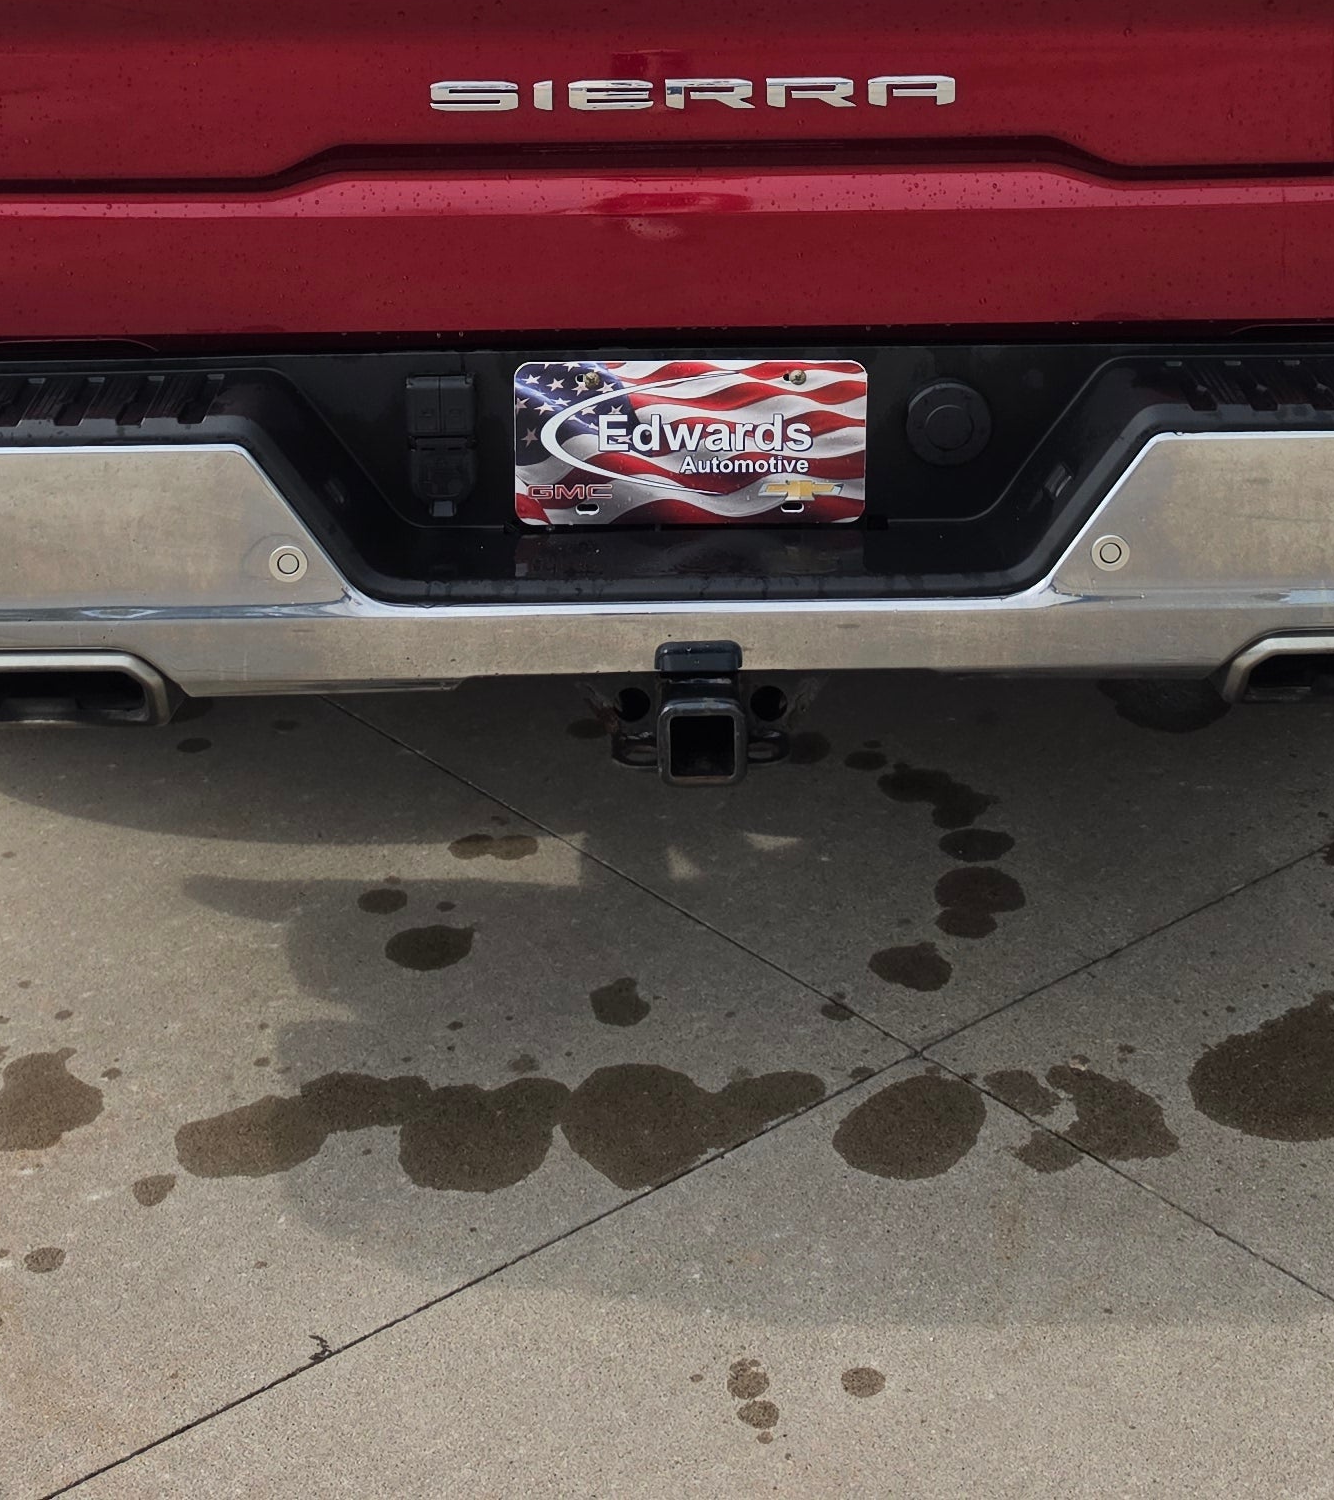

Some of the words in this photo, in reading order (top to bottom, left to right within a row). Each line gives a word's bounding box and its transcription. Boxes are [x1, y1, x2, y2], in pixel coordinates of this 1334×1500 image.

[429, 74, 956, 111] SIERRA
[597, 412, 813, 452] Edwards
[679, 455, 810, 475] Automotive
[527, 483, 613, 500] GMC
